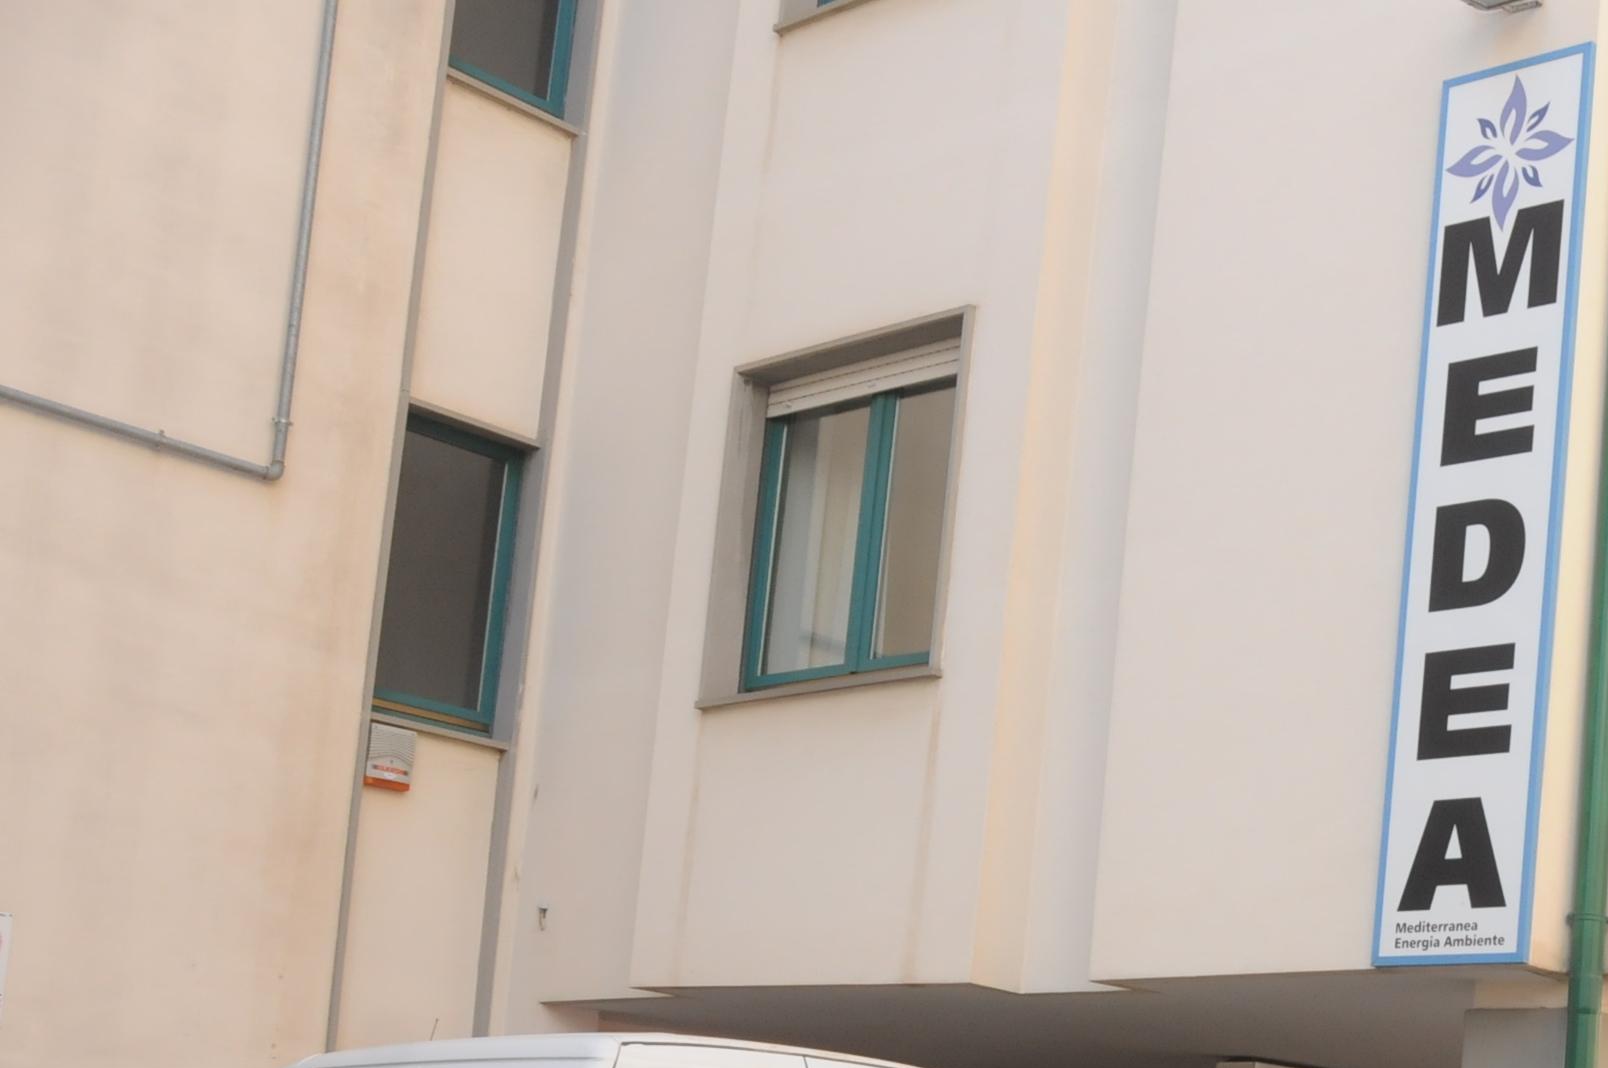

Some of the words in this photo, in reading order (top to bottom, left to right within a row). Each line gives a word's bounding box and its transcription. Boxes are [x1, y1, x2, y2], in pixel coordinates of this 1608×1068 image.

[1397, 198, 1565, 912] MEDEA
[1395, 920, 1478, 934] Mediterranea
[1394, 936, 1440, 951] Energia
[1443, 934, 1505, 947] Ambiente
